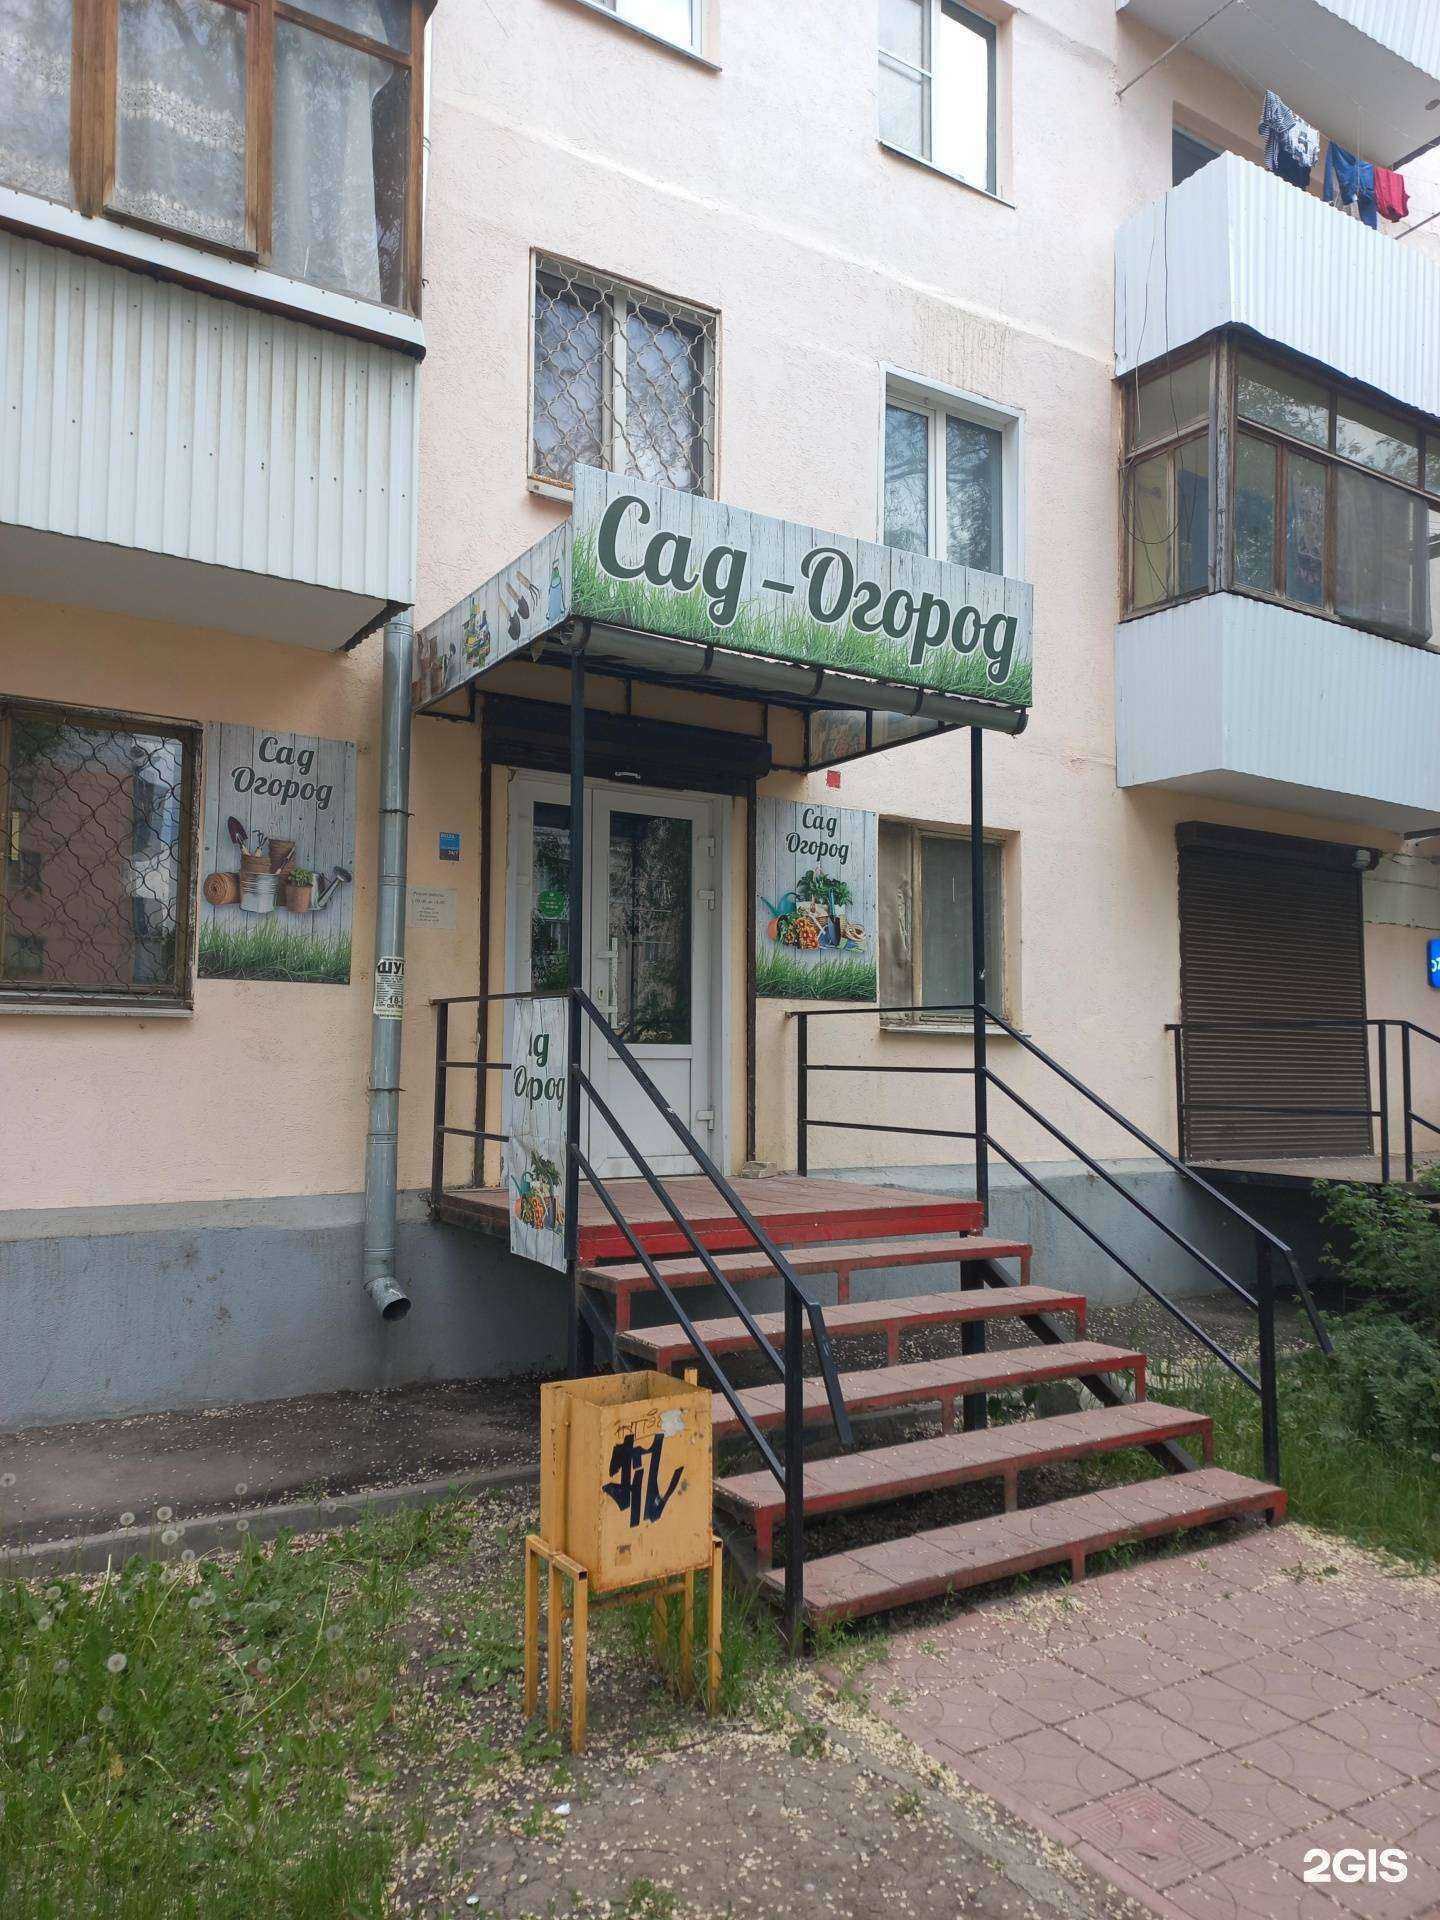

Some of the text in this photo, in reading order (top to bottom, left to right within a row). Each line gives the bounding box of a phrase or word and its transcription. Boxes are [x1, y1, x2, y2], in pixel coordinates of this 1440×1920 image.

[258, 736, 315, 776] Сад
[230, 765, 334, 811] Огород
[802, 807, 838, 838] Сад
[785, 832, 850, 866] Огород
